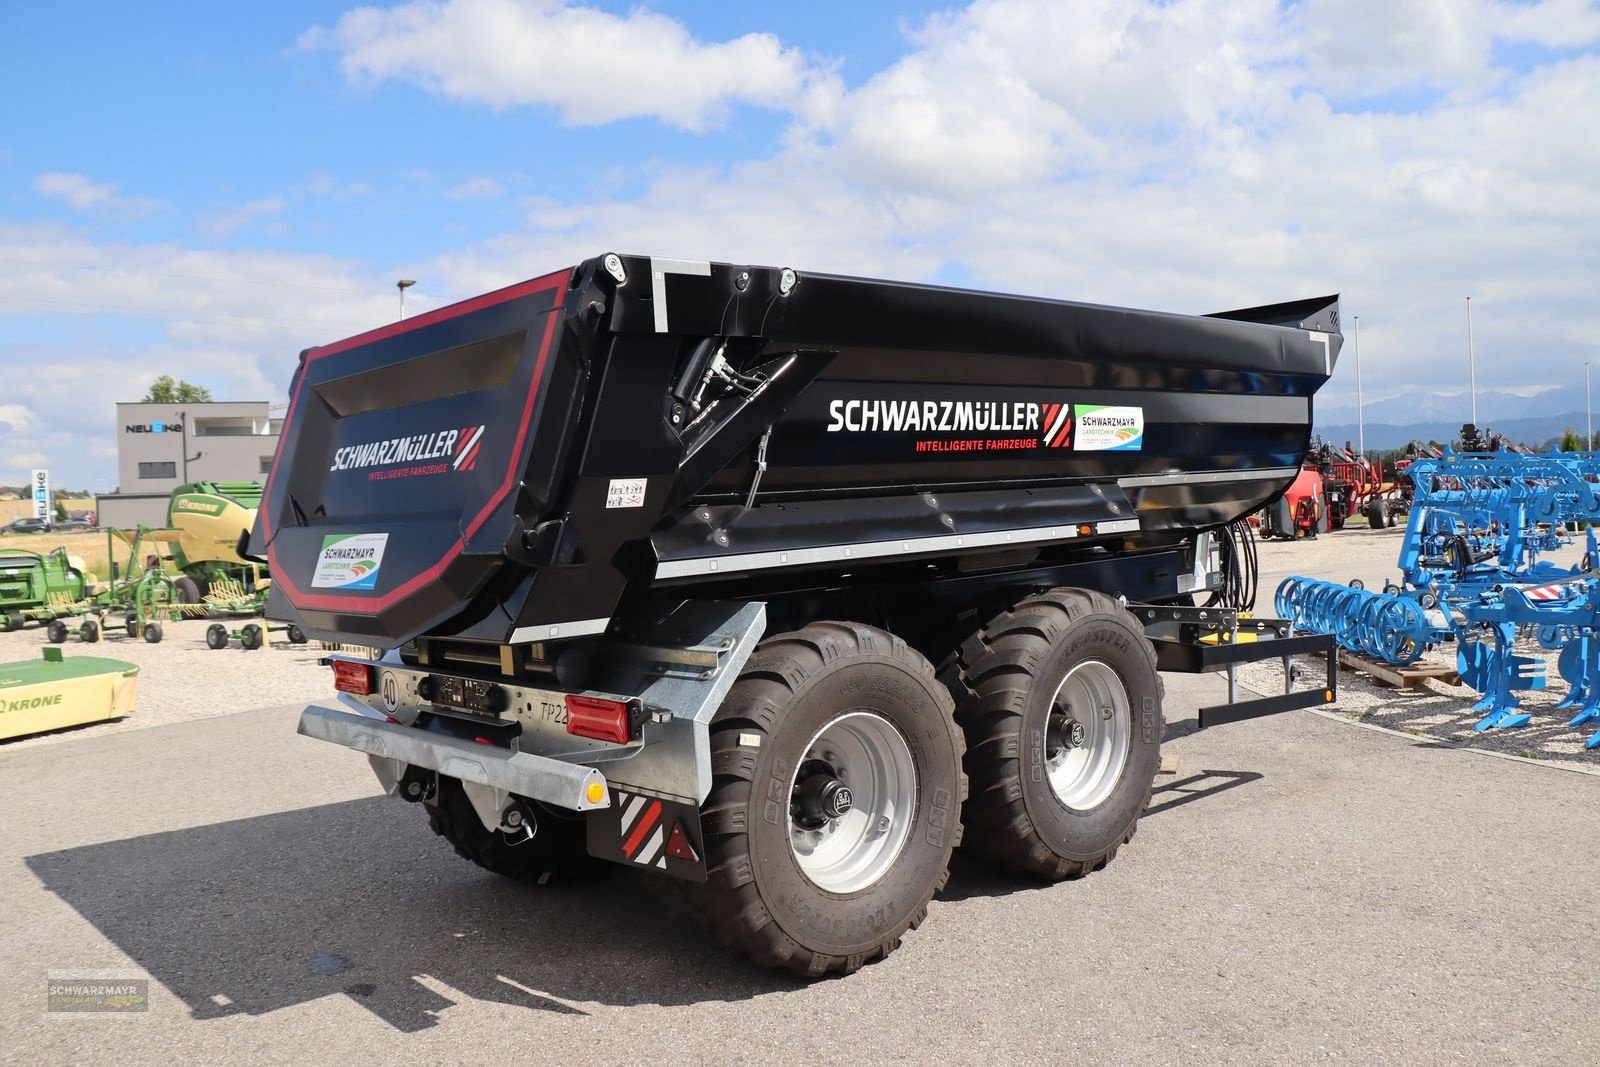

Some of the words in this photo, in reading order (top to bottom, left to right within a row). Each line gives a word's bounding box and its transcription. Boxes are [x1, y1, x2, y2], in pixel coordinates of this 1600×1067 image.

[827, 400, 1039, 432] SCHWARZMÜLLER
[1082, 416, 1135, 427] SCHWARZMAYR
[330, 429, 459, 472] SCHWARZMÜLLER
[916, 440, 984, 452] INTELLIGENTE
[986, 438, 1037, 450] FAHRZEUGE
[368, 468, 408, 481] INTELLIGENTE
[410, 463, 448, 477] FAHRZEUGE
[324, 547, 375, 559] SCHWARZMAYR
[383, 678, 396, 706] 40
[8, 694, 63, 712] KRONE
